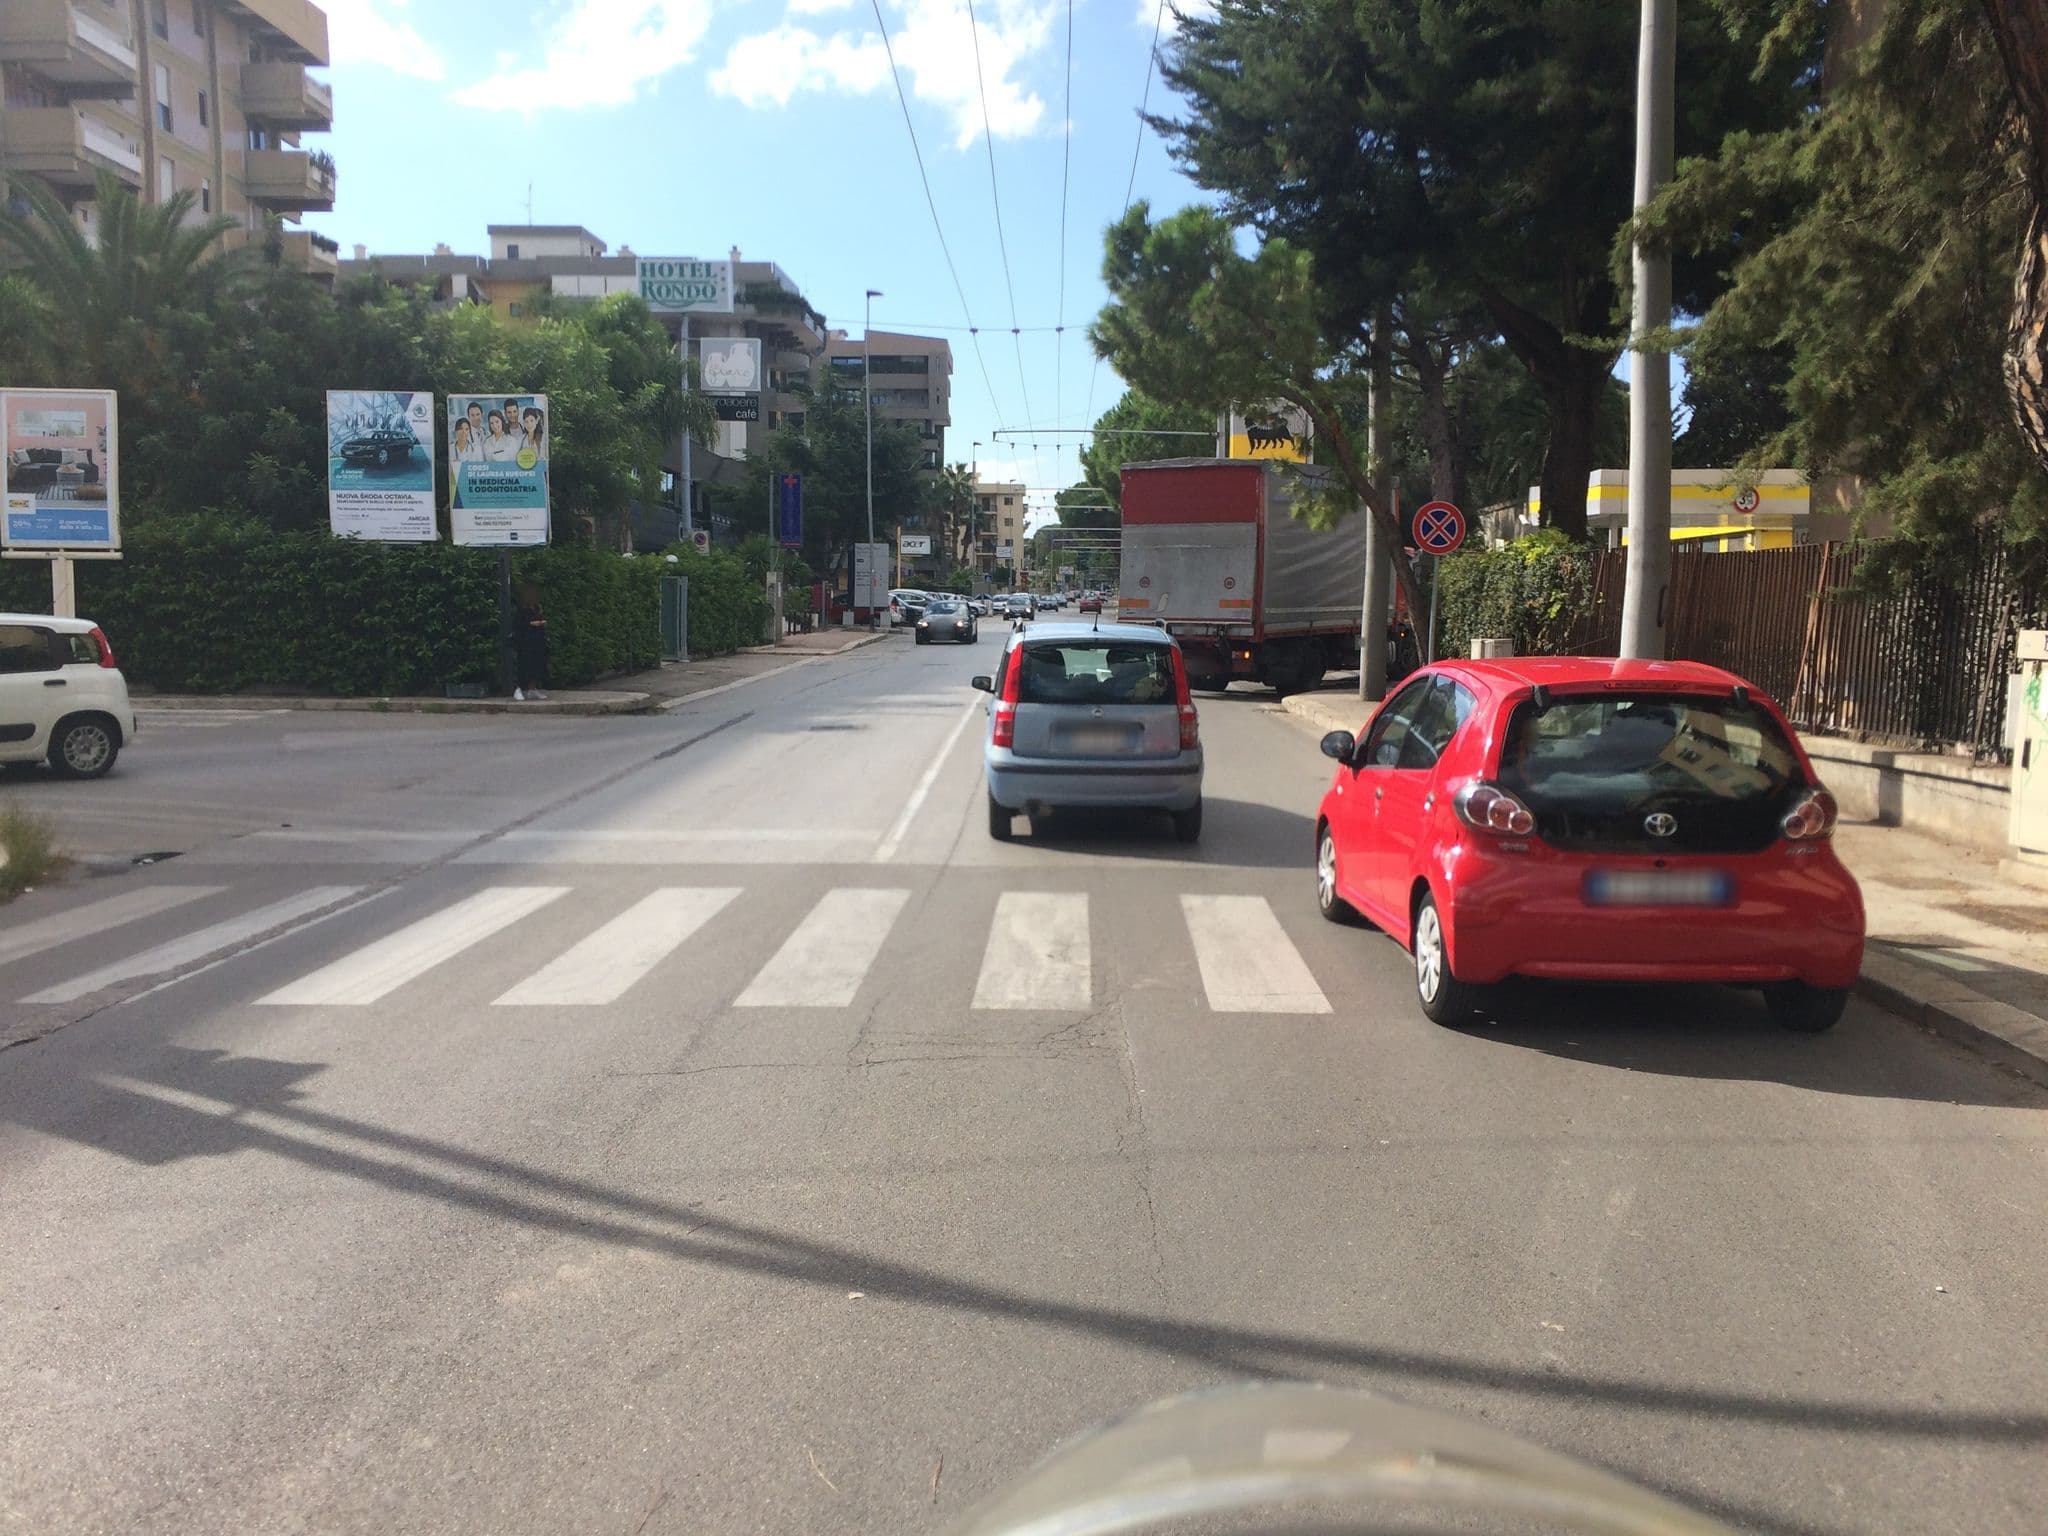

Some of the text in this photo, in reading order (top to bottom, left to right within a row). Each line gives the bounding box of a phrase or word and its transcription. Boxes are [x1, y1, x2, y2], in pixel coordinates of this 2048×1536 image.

[641, 262, 717, 278] HOTEL
[474, 485, 537, 493] ODONTOIATRIA
[902, 540, 926, 548] acer
